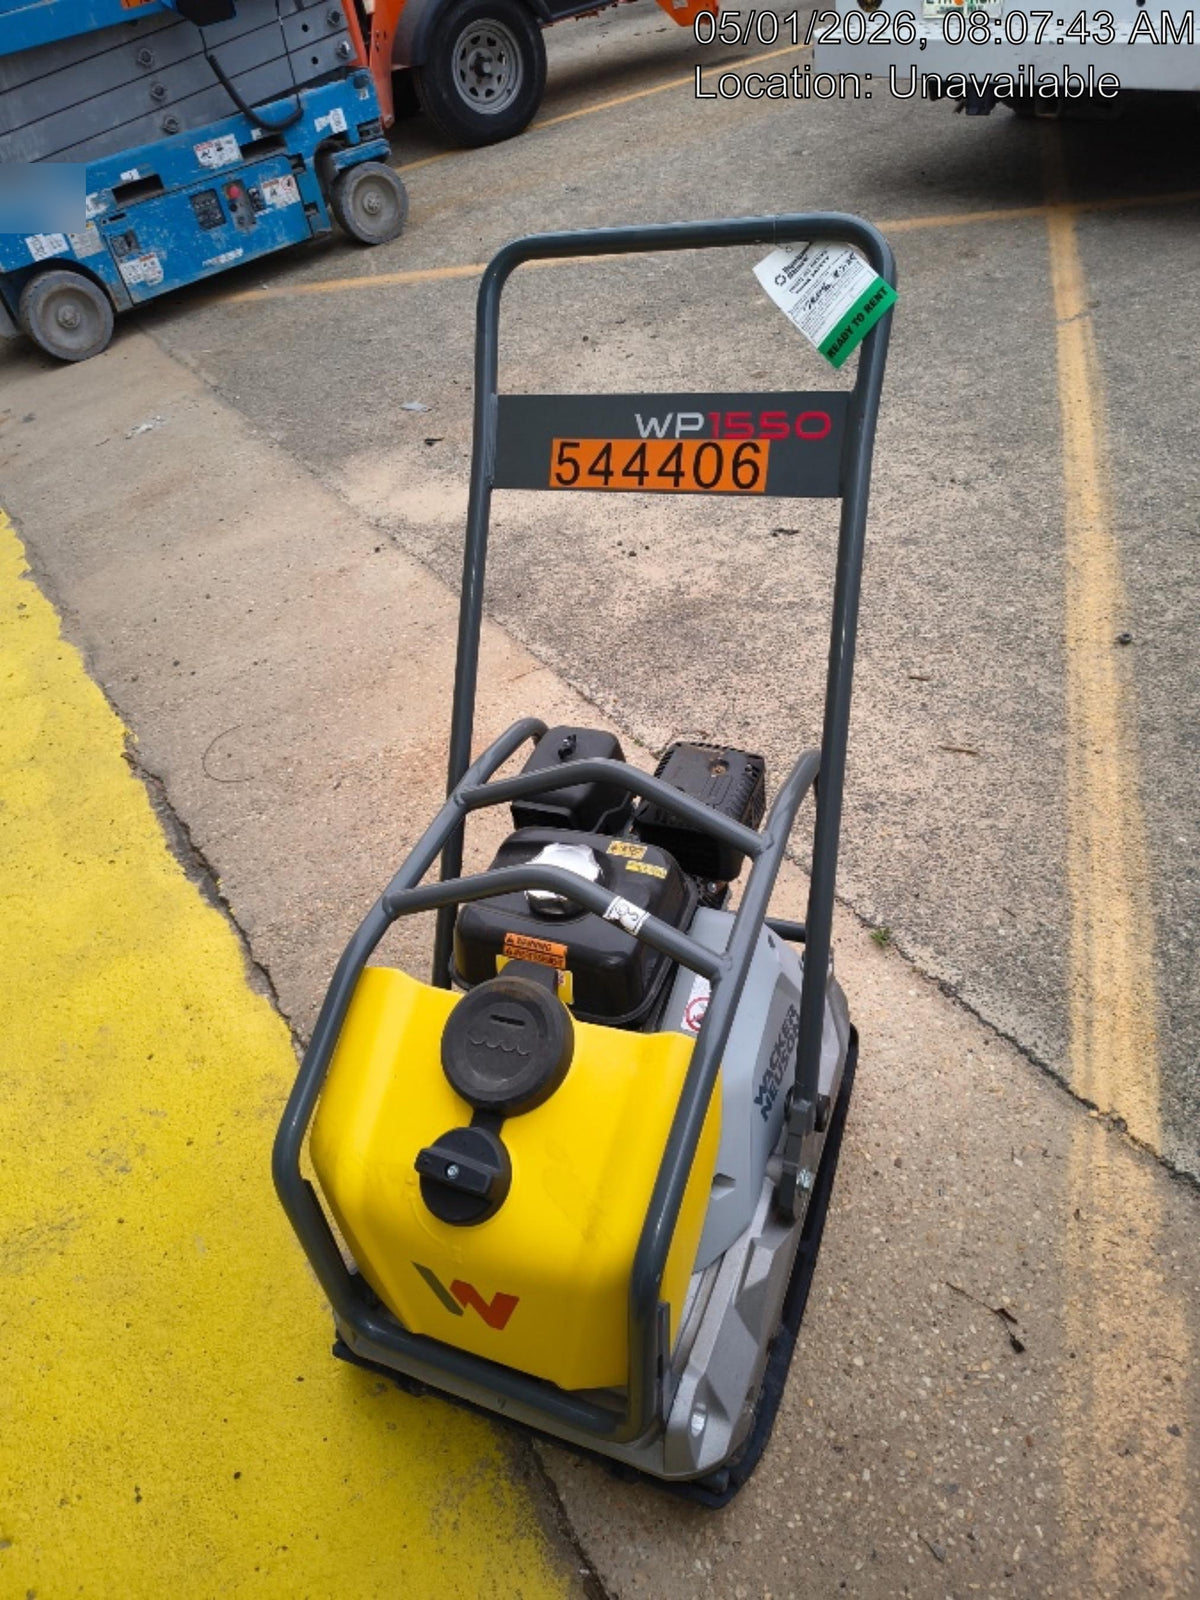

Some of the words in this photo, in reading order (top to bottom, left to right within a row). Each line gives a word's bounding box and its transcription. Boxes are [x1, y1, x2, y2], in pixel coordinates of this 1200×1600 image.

[826, 326, 855, 359] READY
[851, 313, 866, 327] TO
[863, 286, 888, 314] RENT
[635, 410, 832, 440] WP1550
[554, 442, 761, 489] 544406
[753, 1003, 798, 1105] WACKER
